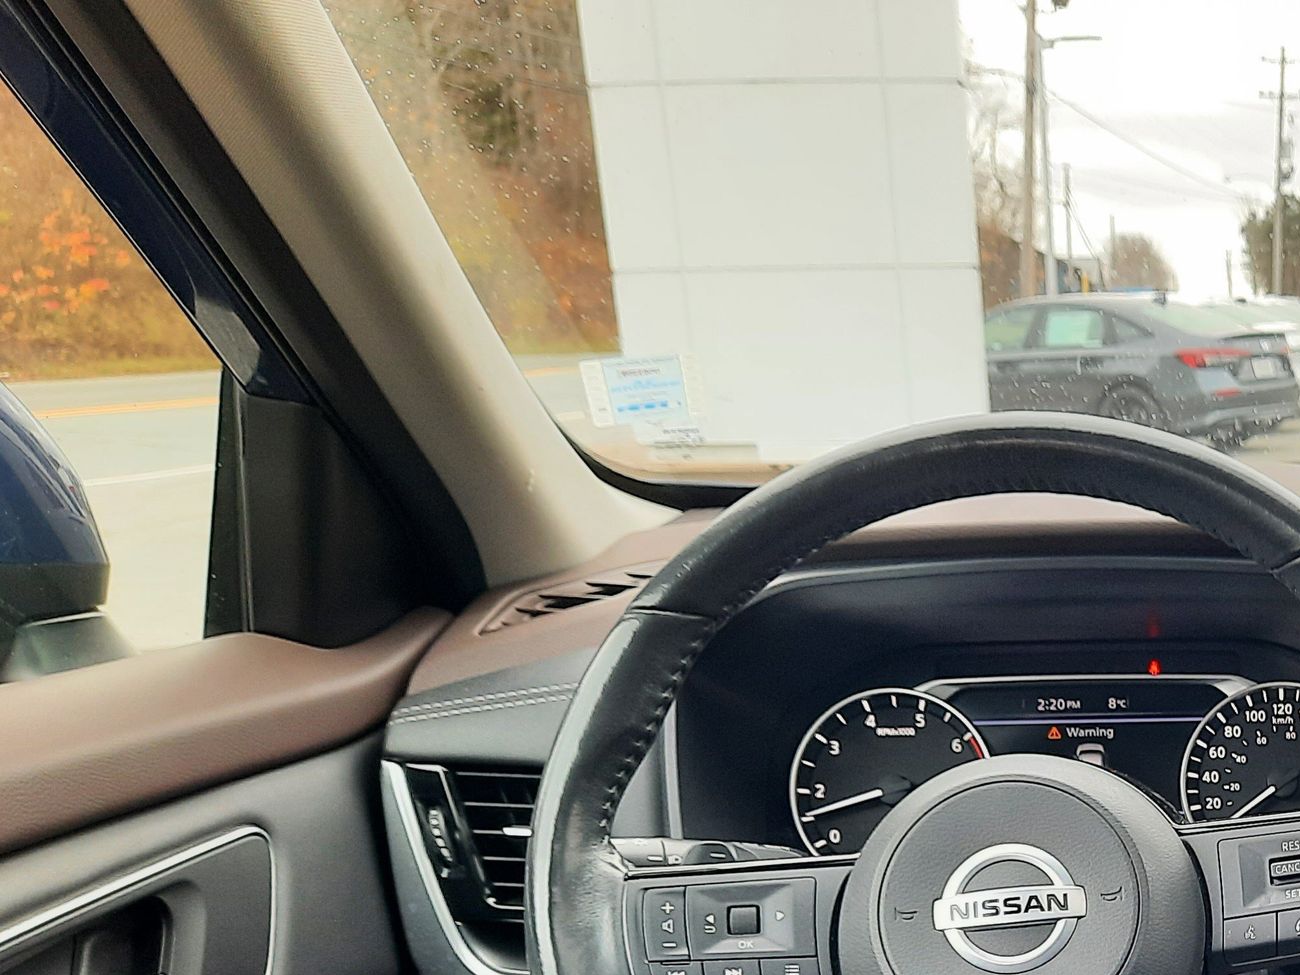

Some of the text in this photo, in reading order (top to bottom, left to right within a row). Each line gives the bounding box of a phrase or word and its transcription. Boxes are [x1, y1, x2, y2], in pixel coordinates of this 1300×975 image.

[1037, 698, 1081, 711] 2:20 PM
[1272, 703, 1293, 716] 120
[864, 714, 876, 728] 4
[914, 713, 926, 728] 5
[1245, 710, 1266, 723] 100
[1271, 716, 1294, 725] km/h
[1066, 727, 1114, 739] Warning
[1223, 726, 1242, 738] 80
[1285, 731, 1297, 740] 80
[828, 740, 840, 755] 3
[951, 738, 963, 753] 6
[1208, 746, 1226, 759] 60
[1235, 754, 1247, 764] 40
[1202, 771, 1220, 784] 40
[814, 784, 826, 799] 2
[1229, 782, 1241, 791] 20
[1205, 797, 1222, 809] 20
[828, 829, 841, 844] 0
[950, 893, 1069, 921] NISSAN
[737, 939, 754, 949] OK
